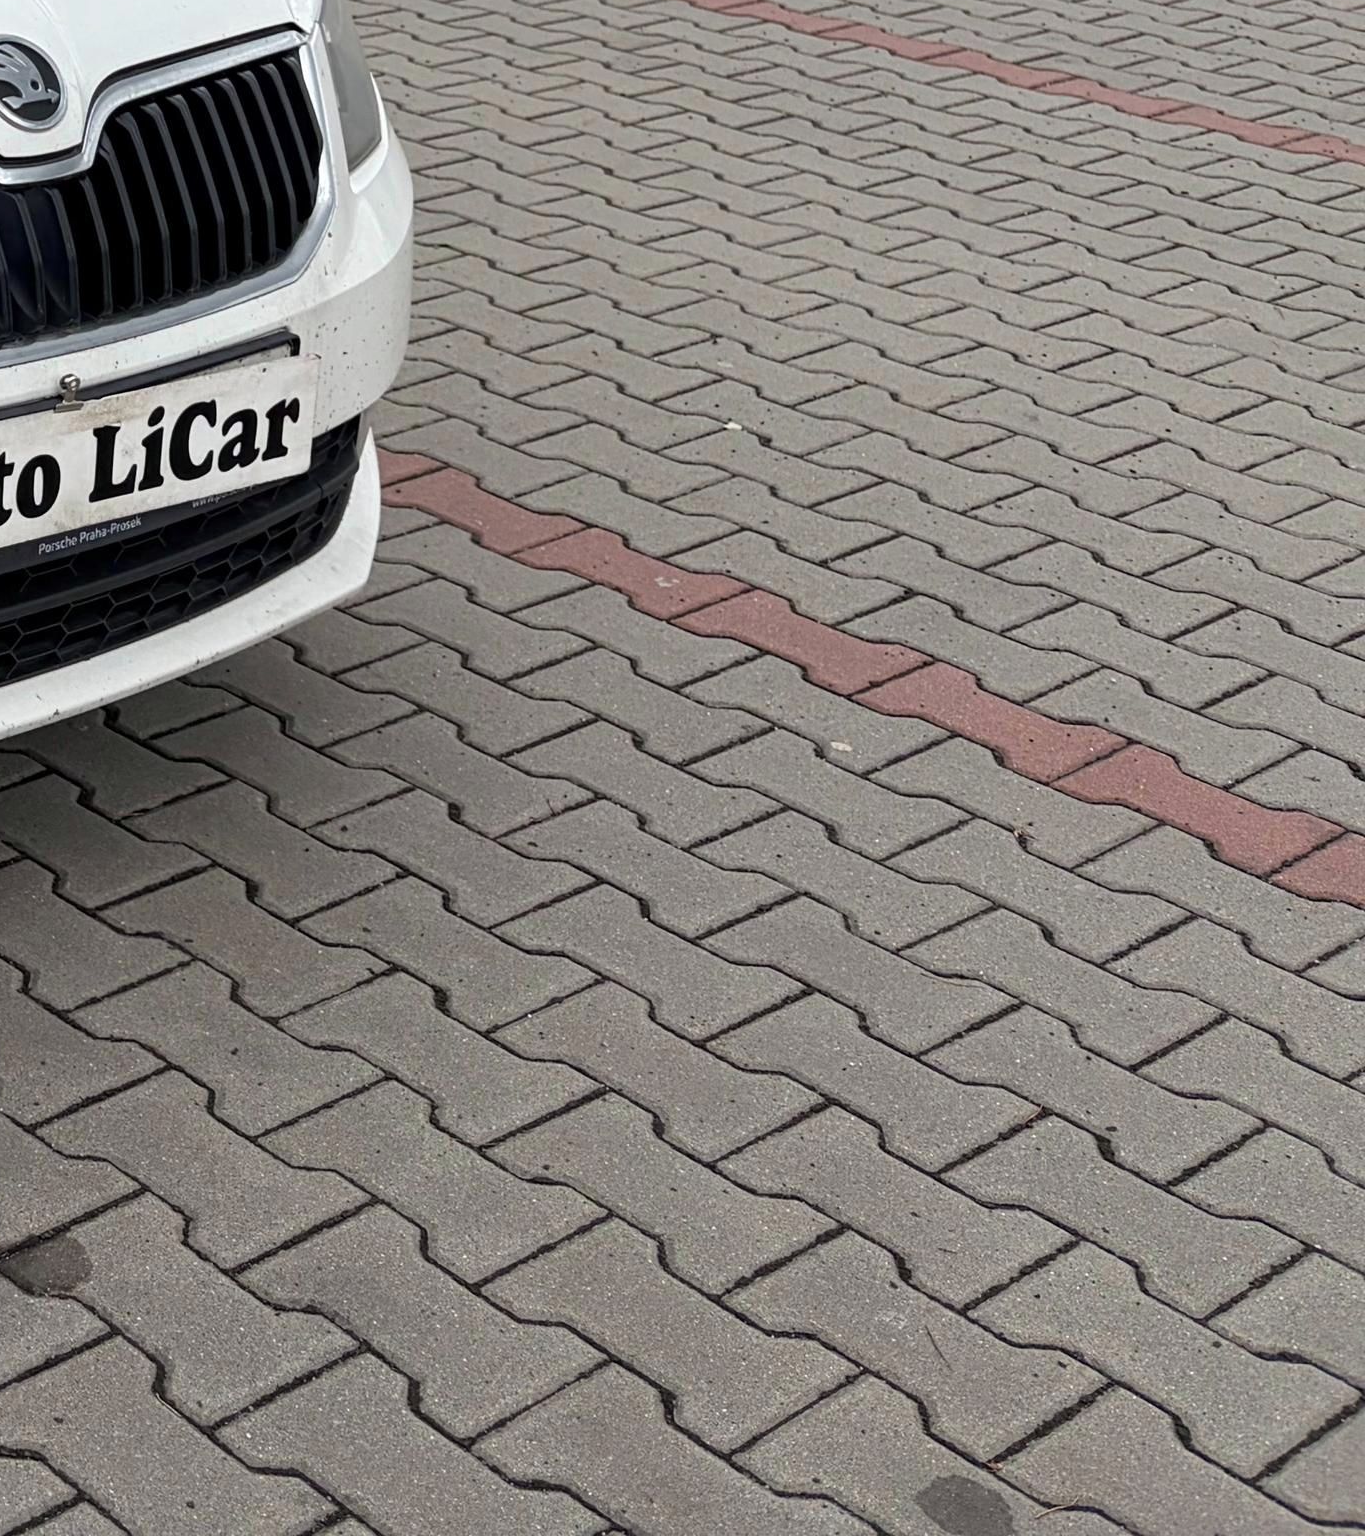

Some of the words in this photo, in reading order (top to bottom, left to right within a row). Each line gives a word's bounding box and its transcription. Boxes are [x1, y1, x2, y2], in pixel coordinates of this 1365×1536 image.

[88, 397, 300, 504] LiCar
[38, 534, 78, 556] Porsche
[79, 514, 142, 544] Praha-Prosek
